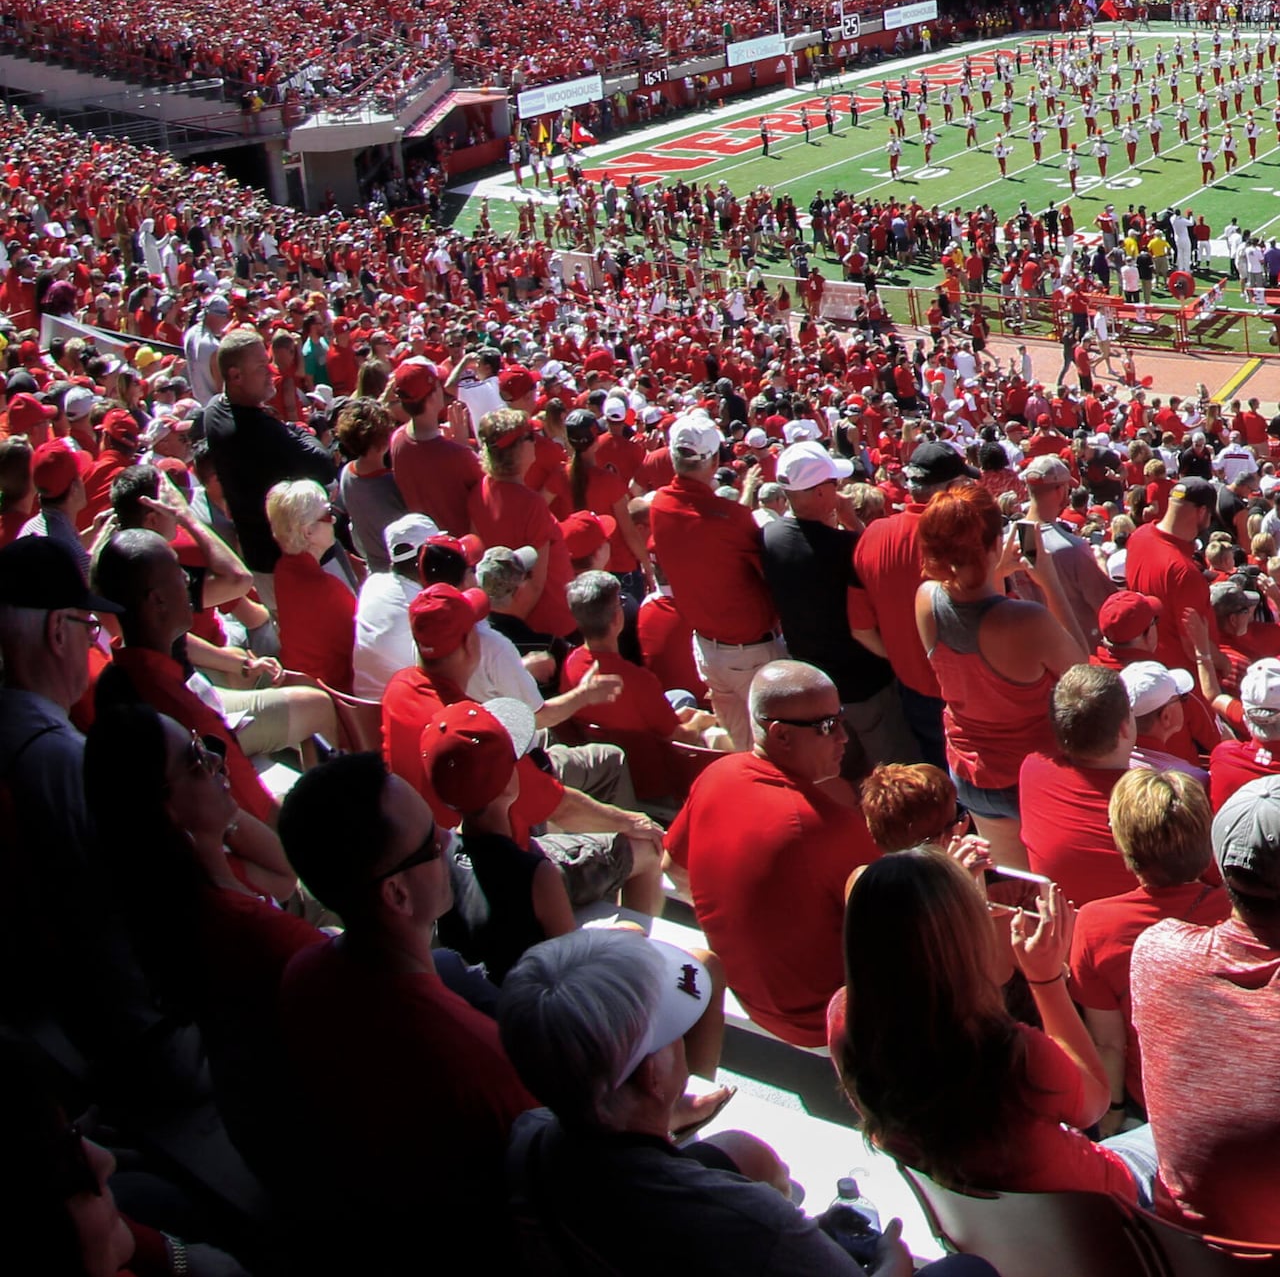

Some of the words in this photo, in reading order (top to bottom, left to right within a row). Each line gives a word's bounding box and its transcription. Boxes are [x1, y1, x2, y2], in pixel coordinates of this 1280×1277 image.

[902, 6, 936, 20] WOODHOUSE
[844, 17, 858, 34] 25
[850, 42, 859, 55] N
[643, 68, 669, 86] 16:47
[723, 72, 733, 86] N
[546, 82, 600, 104] WOODHOUSE
[651, 90, 662, 106] N
